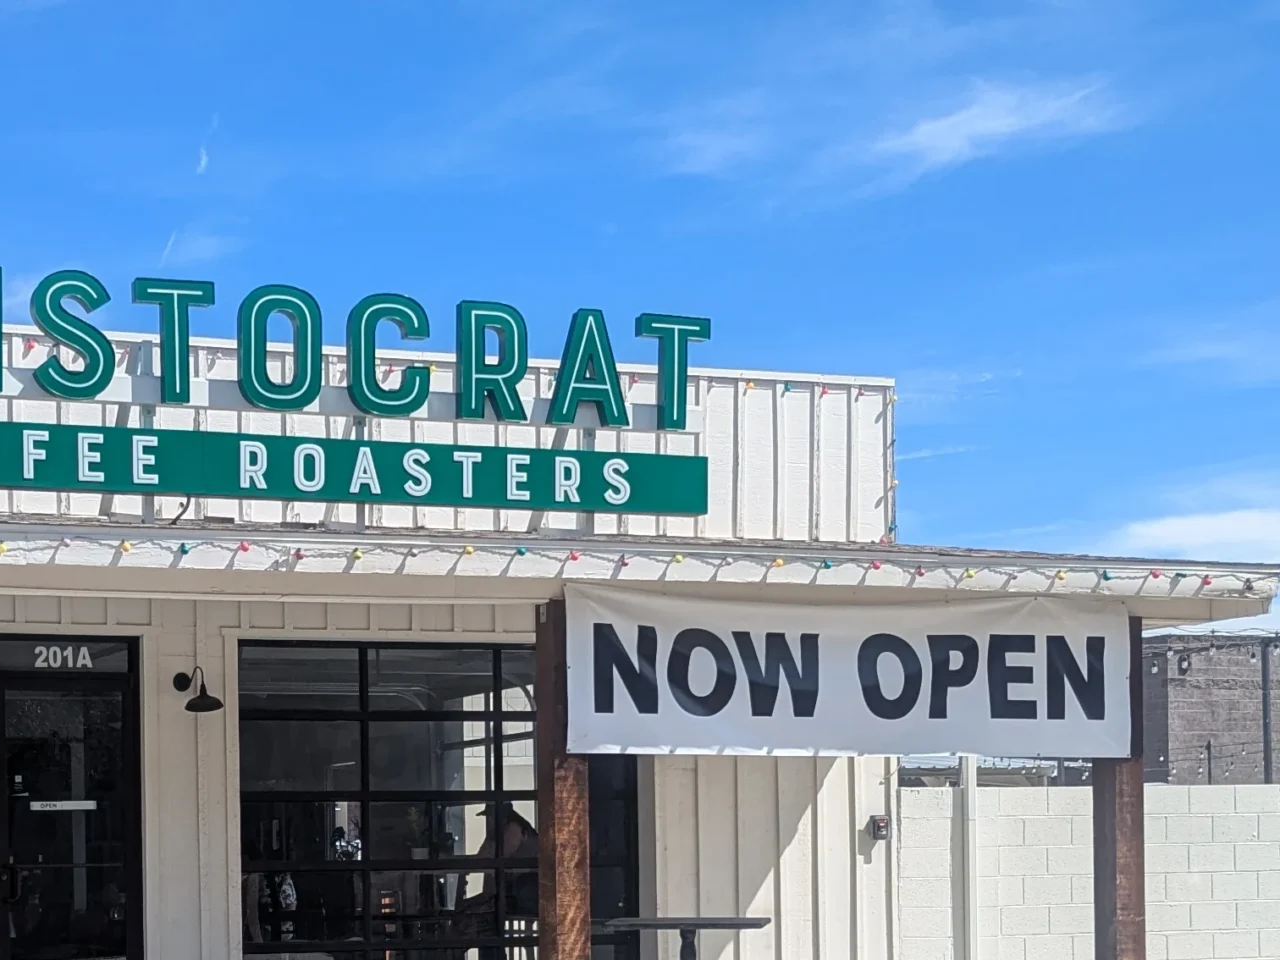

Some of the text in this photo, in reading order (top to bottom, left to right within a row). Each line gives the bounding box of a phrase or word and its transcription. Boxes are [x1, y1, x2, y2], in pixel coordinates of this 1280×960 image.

[239, 440, 631, 507] ROASTERS
[34, 646, 93, 668] 201A
[593, 623, 1106, 720] NOW OPEN
